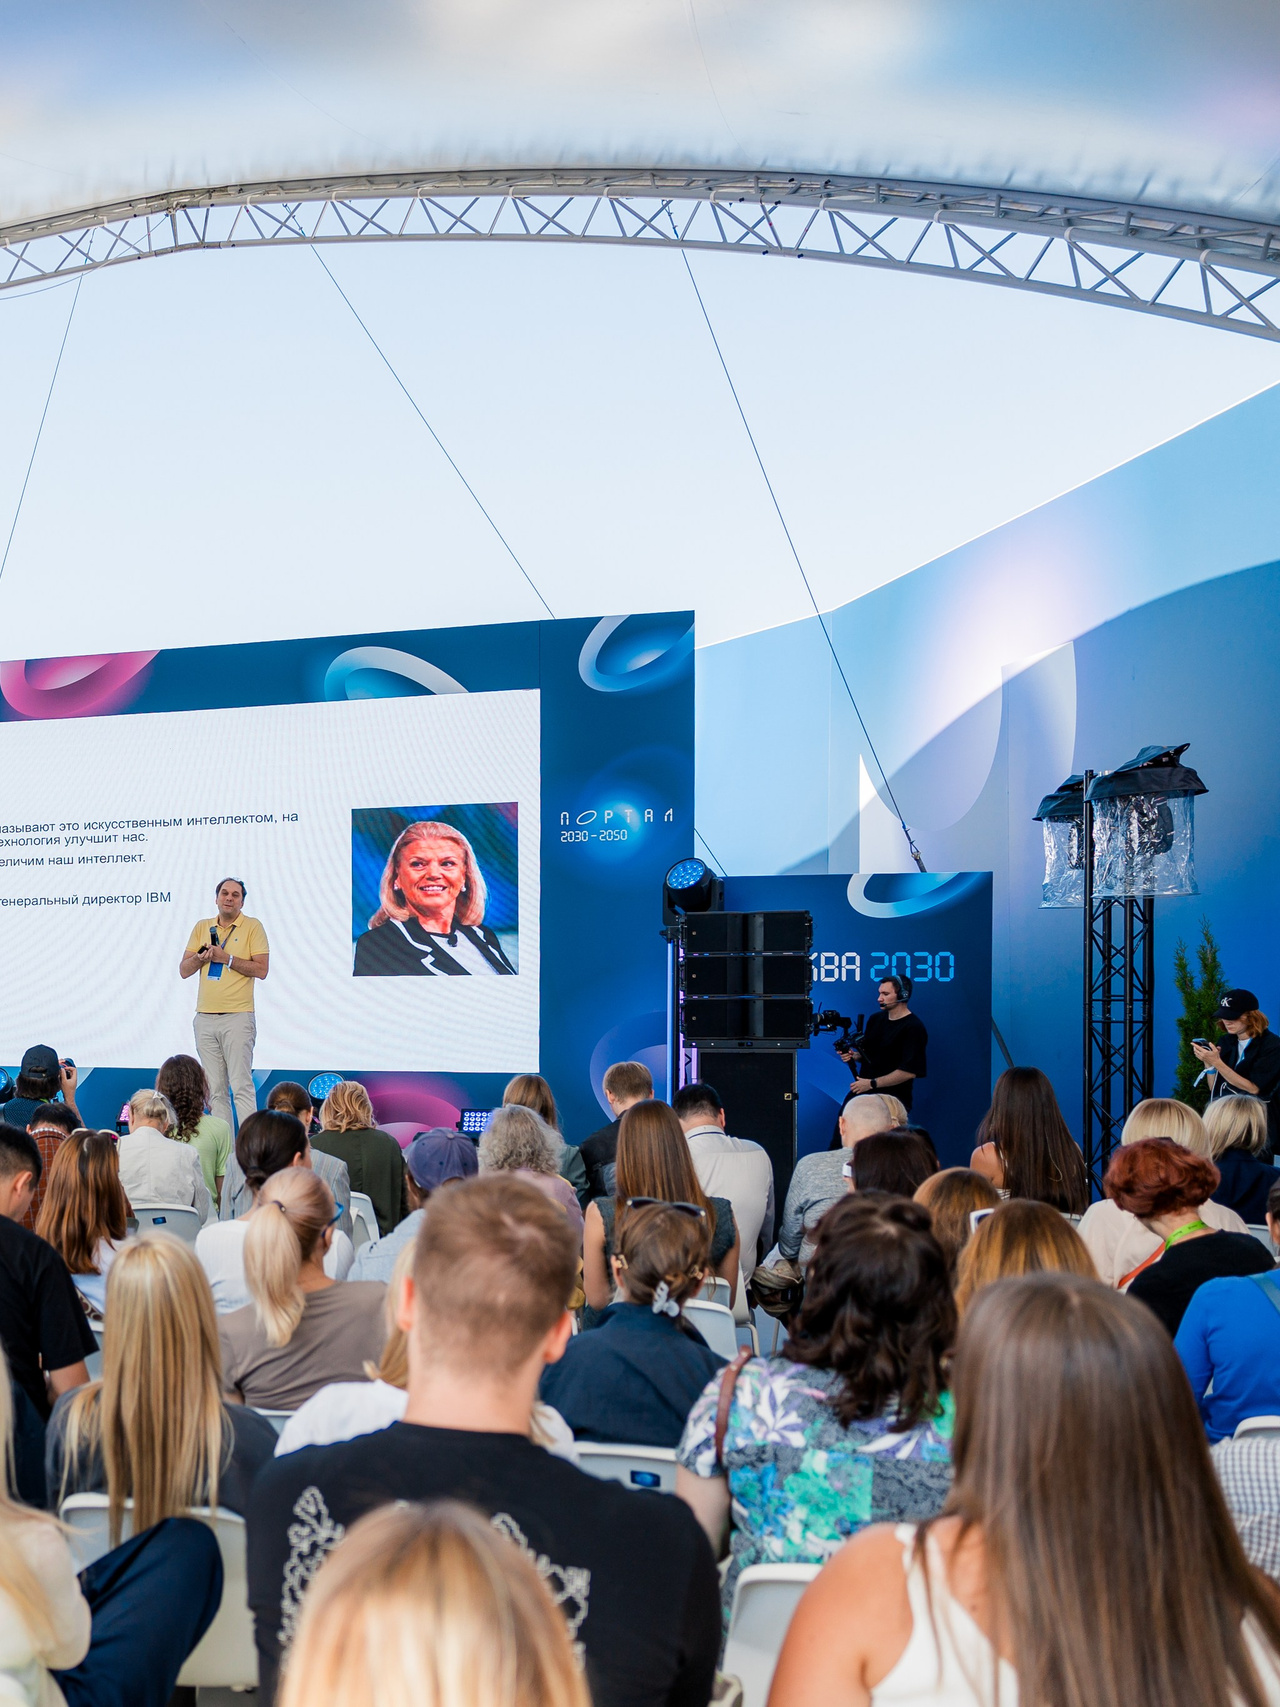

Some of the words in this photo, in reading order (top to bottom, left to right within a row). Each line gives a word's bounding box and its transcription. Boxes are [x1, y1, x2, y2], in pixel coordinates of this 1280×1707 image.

[58, 822, 80, 832] это
[83, 818, 183, 833] искусственным
[186, 813, 278, 827] интеллектом,
[282, 812, 299, 823] на
[560, 807, 673, 826] ПОРТАЛ
[64, 834, 118, 848] улучшит
[122, 832, 149, 843] нас.
[48, 856, 74, 866] наш
[77, 853, 146, 865] интеллект.
[81, 894, 143, 907] директор
[146, 891, 171, 903] IBM
[870, 951, 955, 983] 2030
